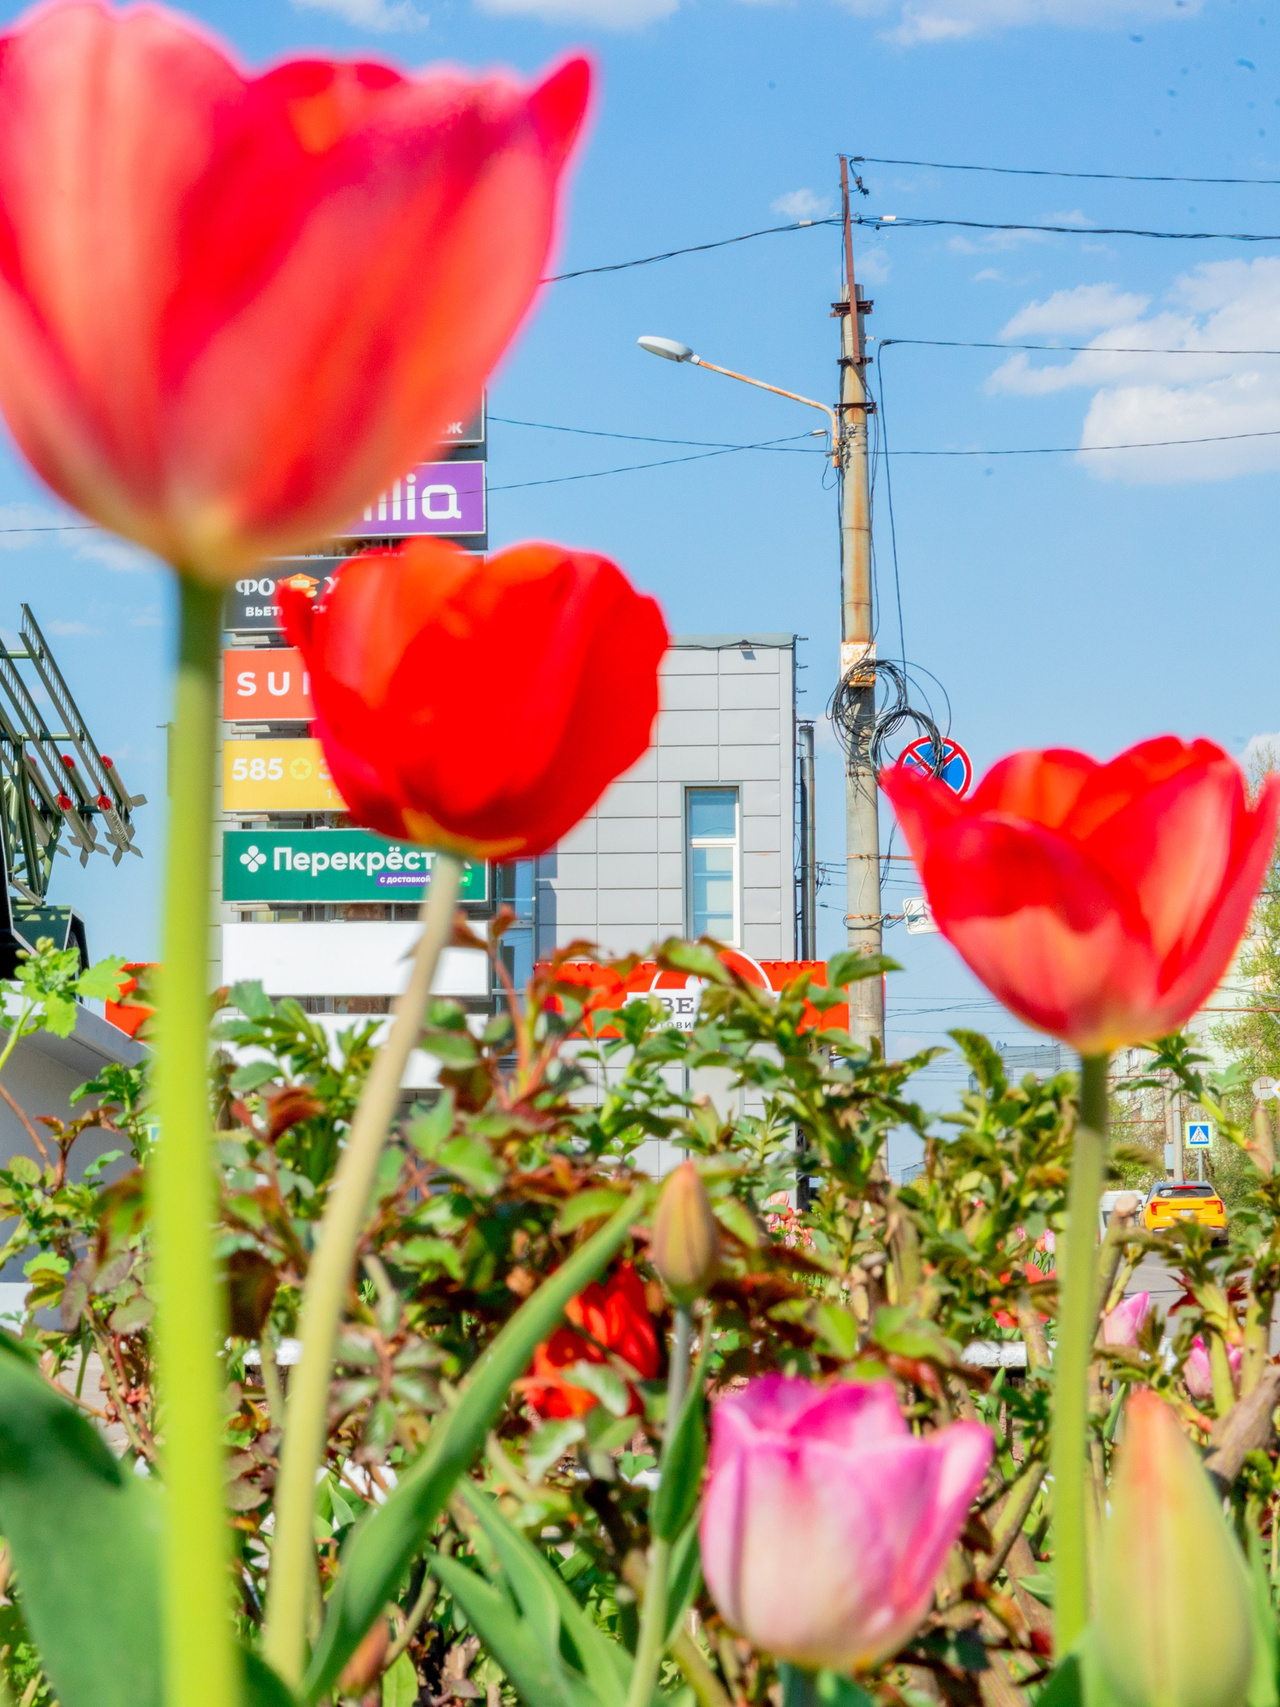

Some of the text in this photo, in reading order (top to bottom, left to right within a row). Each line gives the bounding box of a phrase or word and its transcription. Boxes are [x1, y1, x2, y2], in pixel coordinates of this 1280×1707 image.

[231, 757, 284, 781] 585
[273, 845, 471, 876] Перекрёст
[386, 875, 431, 884] доставкой
